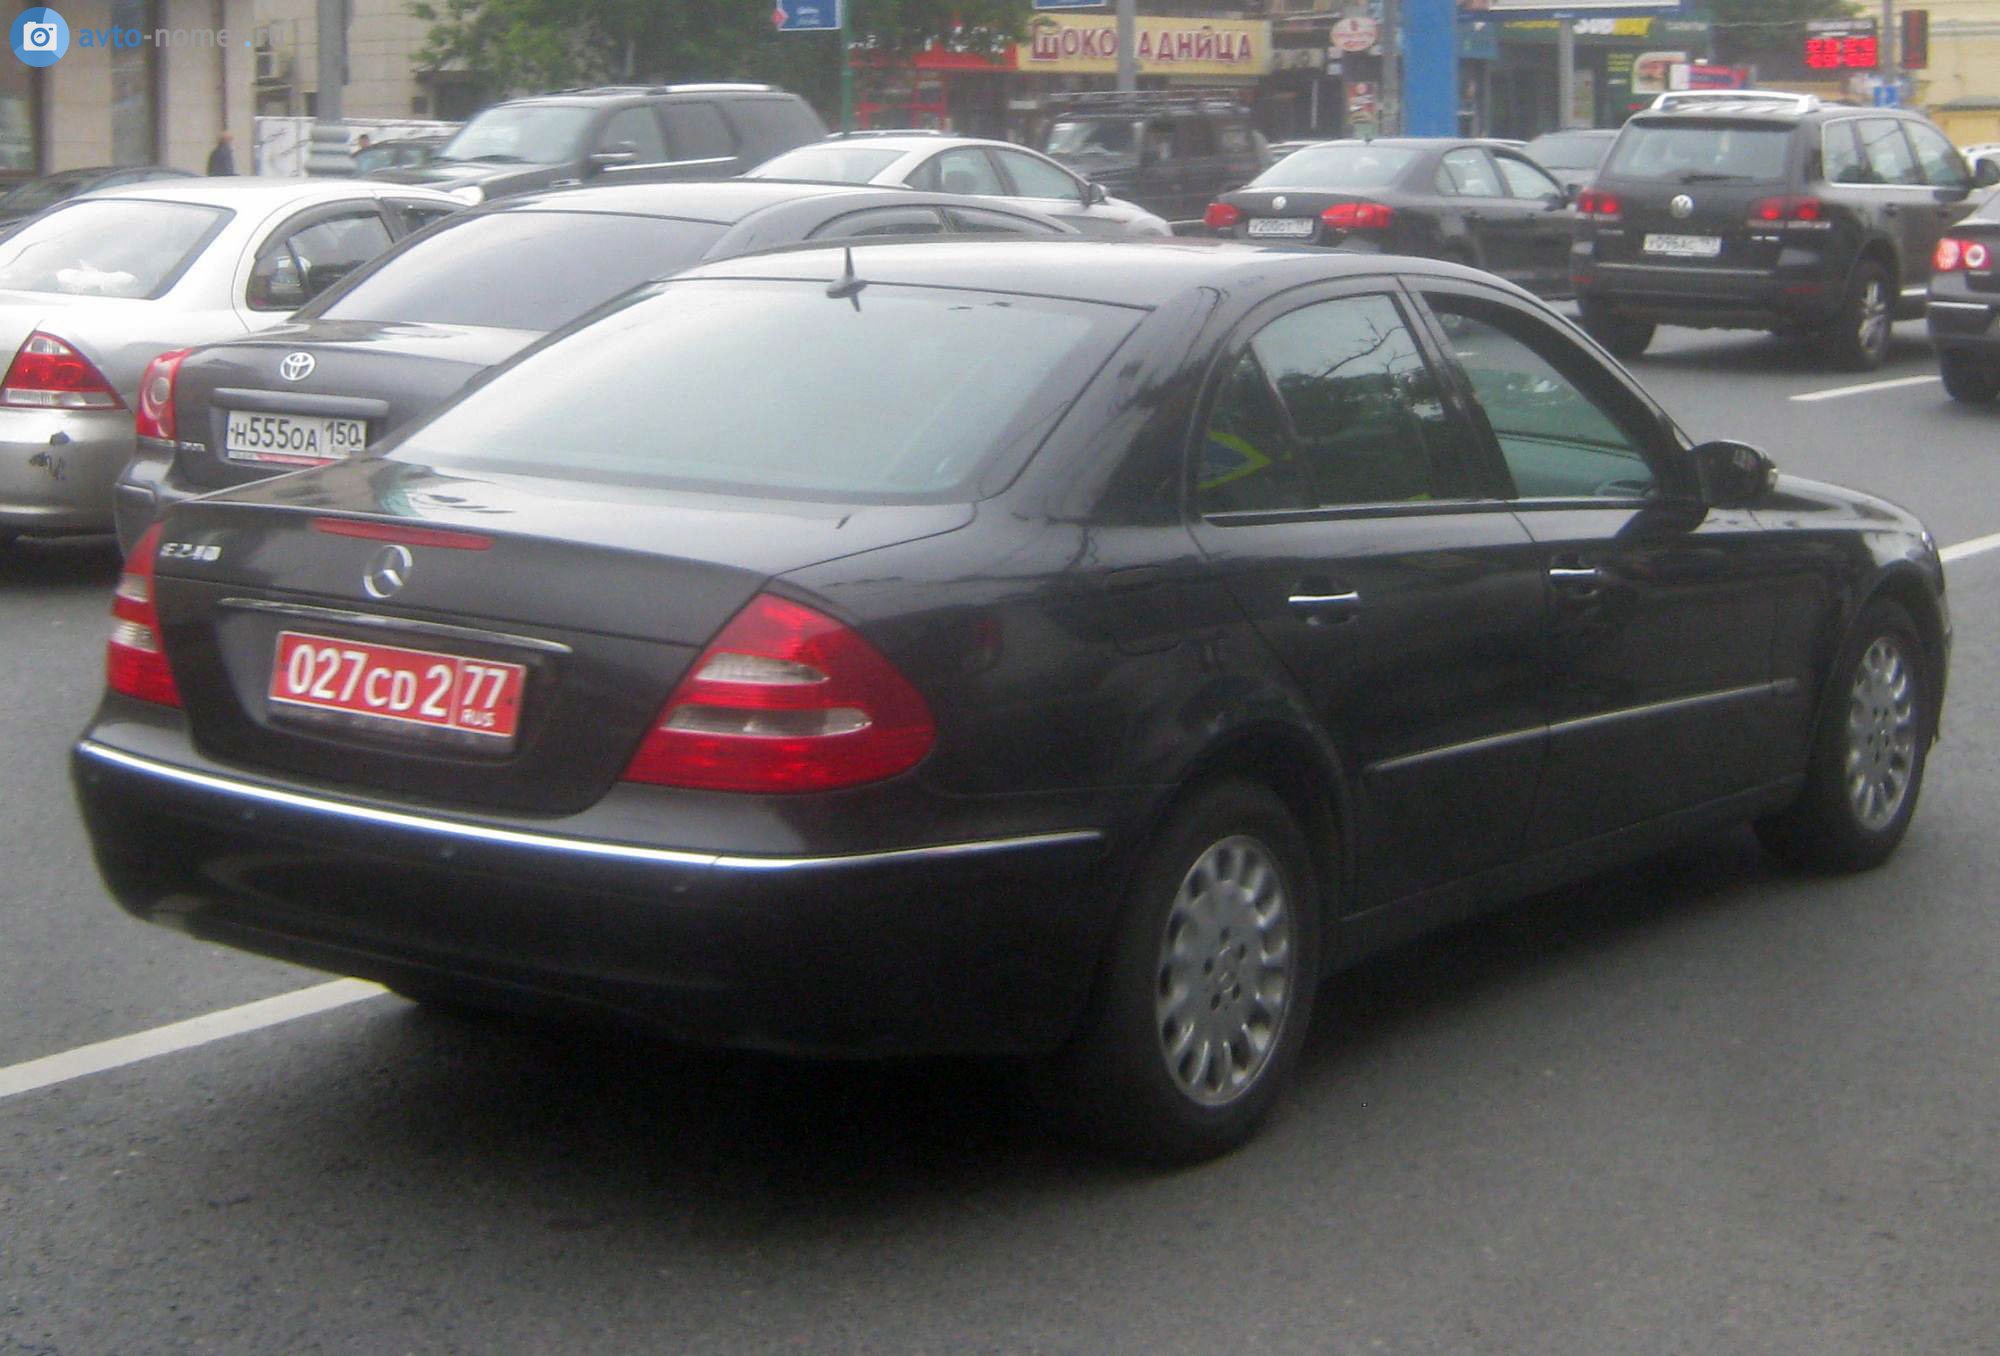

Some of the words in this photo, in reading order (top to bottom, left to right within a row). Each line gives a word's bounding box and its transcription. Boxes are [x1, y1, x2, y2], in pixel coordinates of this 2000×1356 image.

[325, 421, 360, 446] 150
[462, 665, 508, 709] 77
[460, 707, 497, 728] RUS
